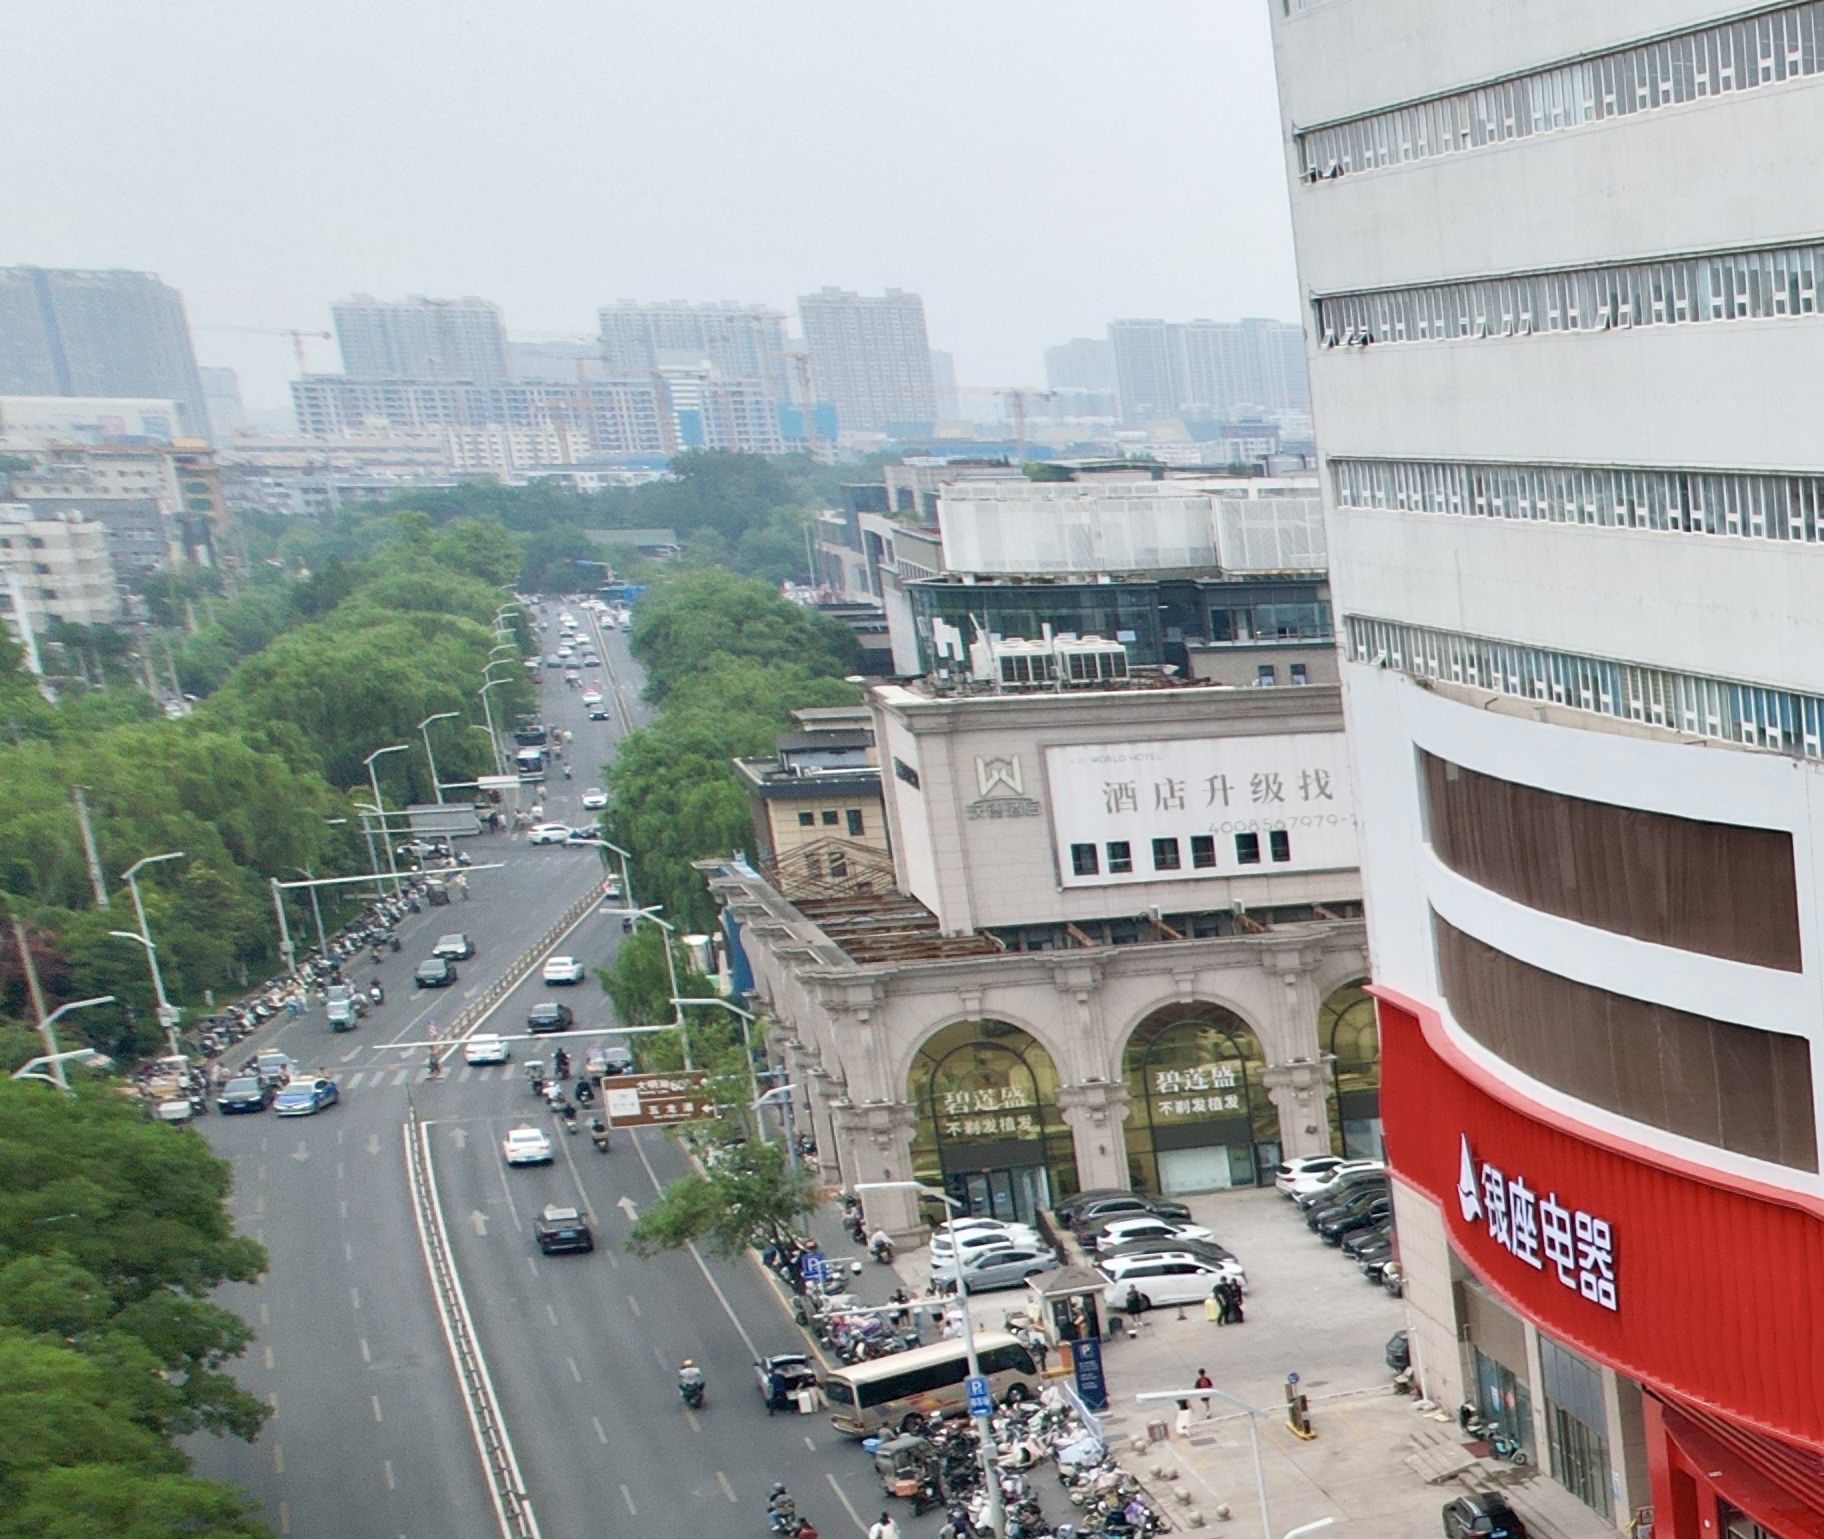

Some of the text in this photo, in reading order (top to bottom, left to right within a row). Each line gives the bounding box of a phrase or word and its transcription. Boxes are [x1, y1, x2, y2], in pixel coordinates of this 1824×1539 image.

[1156, 1065, 1236, 1094] 碧莲盛
[944, 1086, 1025, 1115] 碧莲盛
[1481, 1163, 1618, 1312] 银座电器
